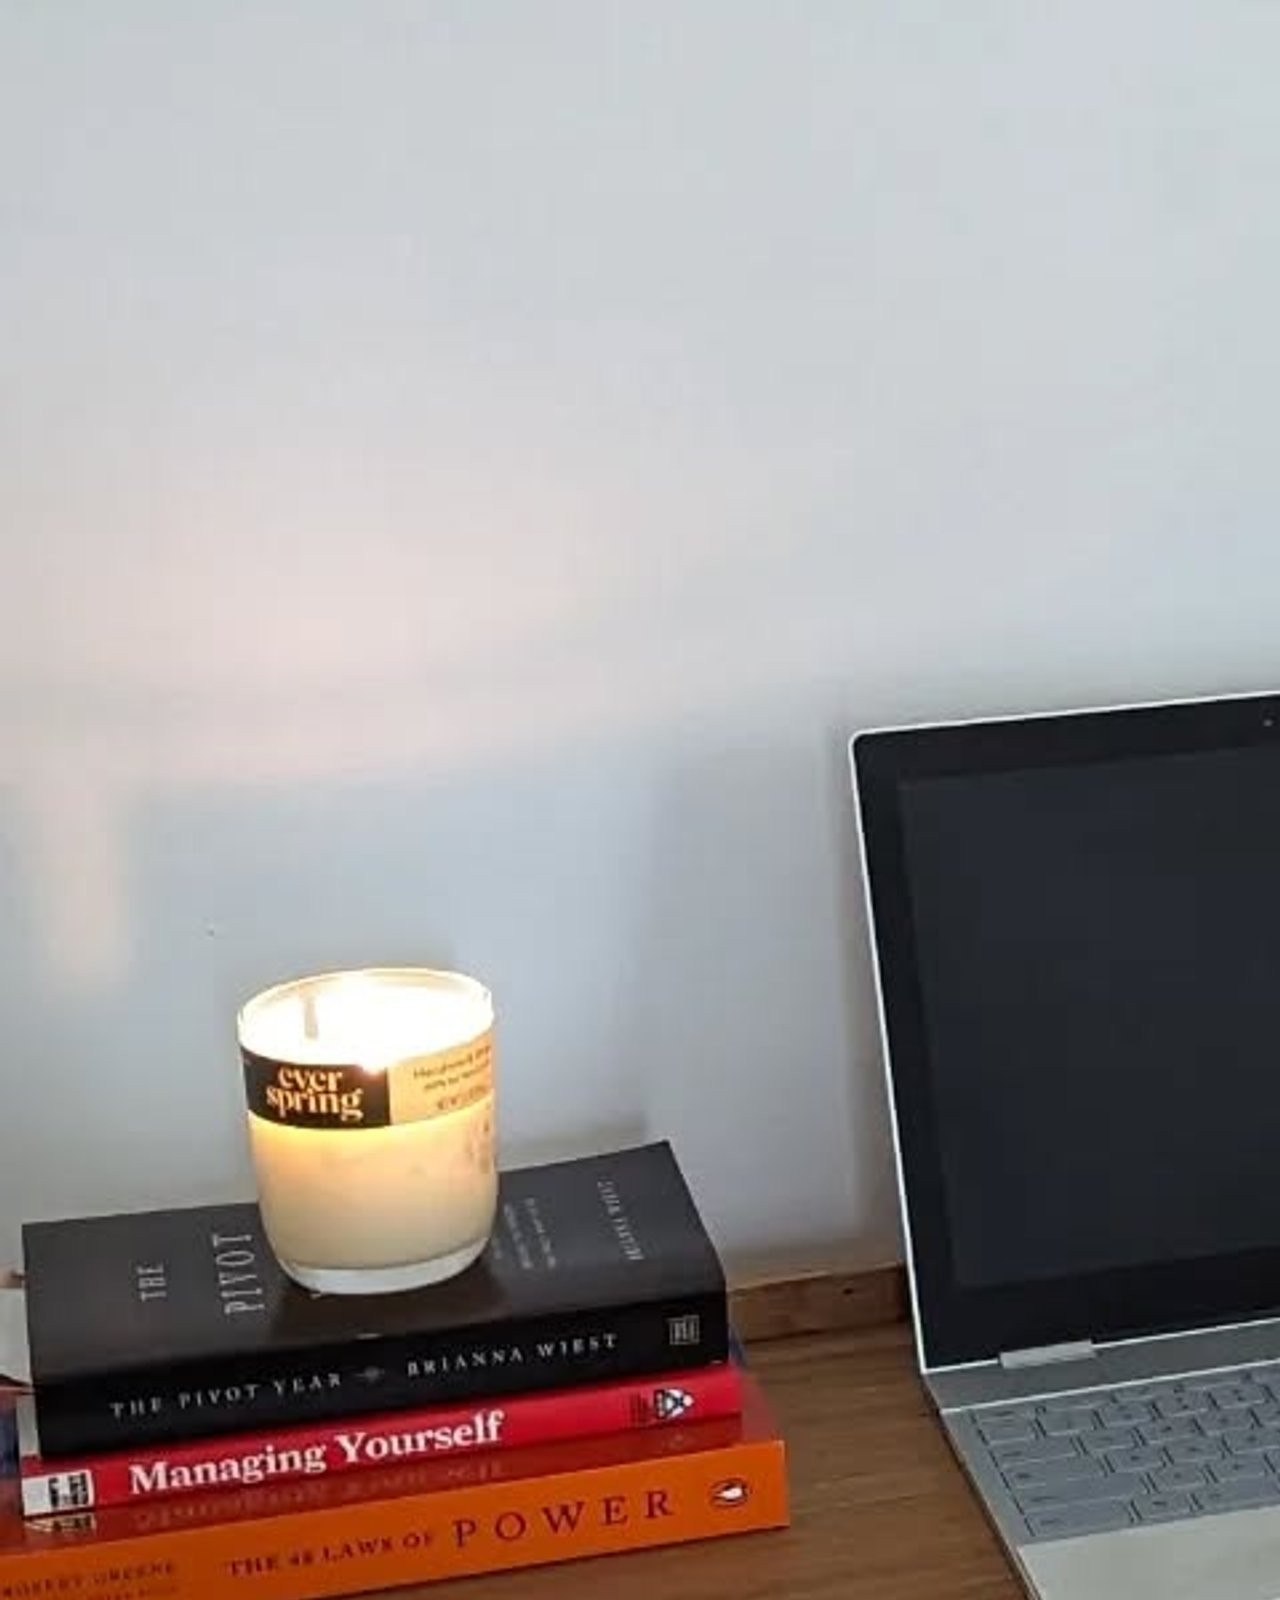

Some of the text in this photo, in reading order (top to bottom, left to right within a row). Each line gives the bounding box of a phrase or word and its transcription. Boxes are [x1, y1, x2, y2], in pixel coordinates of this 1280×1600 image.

[277, 1065, 344, 1092] ever
[265, 1084, 365, 1123] spring
[136, 1262, 168, 1302] THE
[212, 1233, 266, 1315] PIVOT
[406, 1332, 618, 1377] BRIANNA WIEST
[110, 1372, 342, 1419] THE PIVOT YEAR
[128, 1444, 328, 1495] Managing
[334, 1408, 506, 1464] Yourself
[229, 1555, 279, 1577] THE
[452, 1489, 675, 1549] POWER
